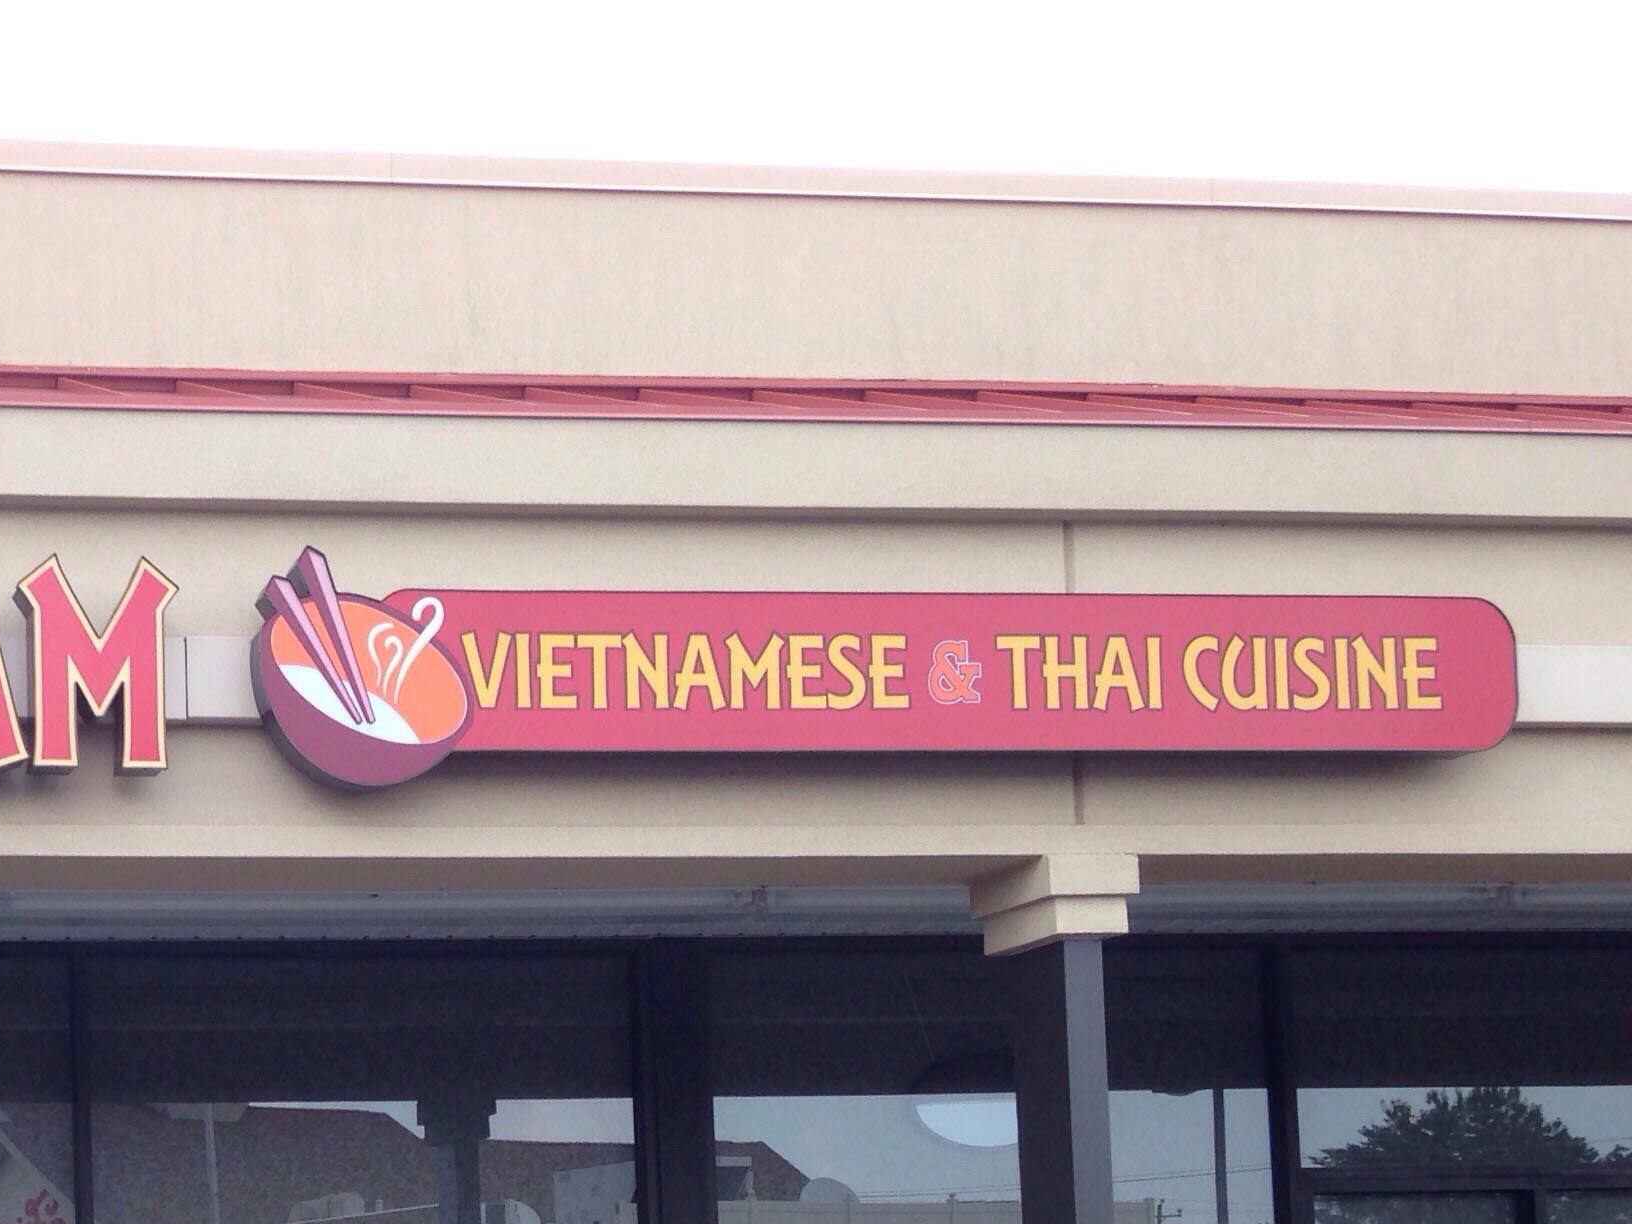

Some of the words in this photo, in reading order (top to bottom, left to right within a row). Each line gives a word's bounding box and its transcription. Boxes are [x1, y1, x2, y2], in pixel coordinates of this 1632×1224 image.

[460, 630, 911, 711] VIETNAMESE
[926, 639, 982, 704] &
[995, 634, 1164, 712] THAI
[1182, 633, 1444, 712] CUISINE
